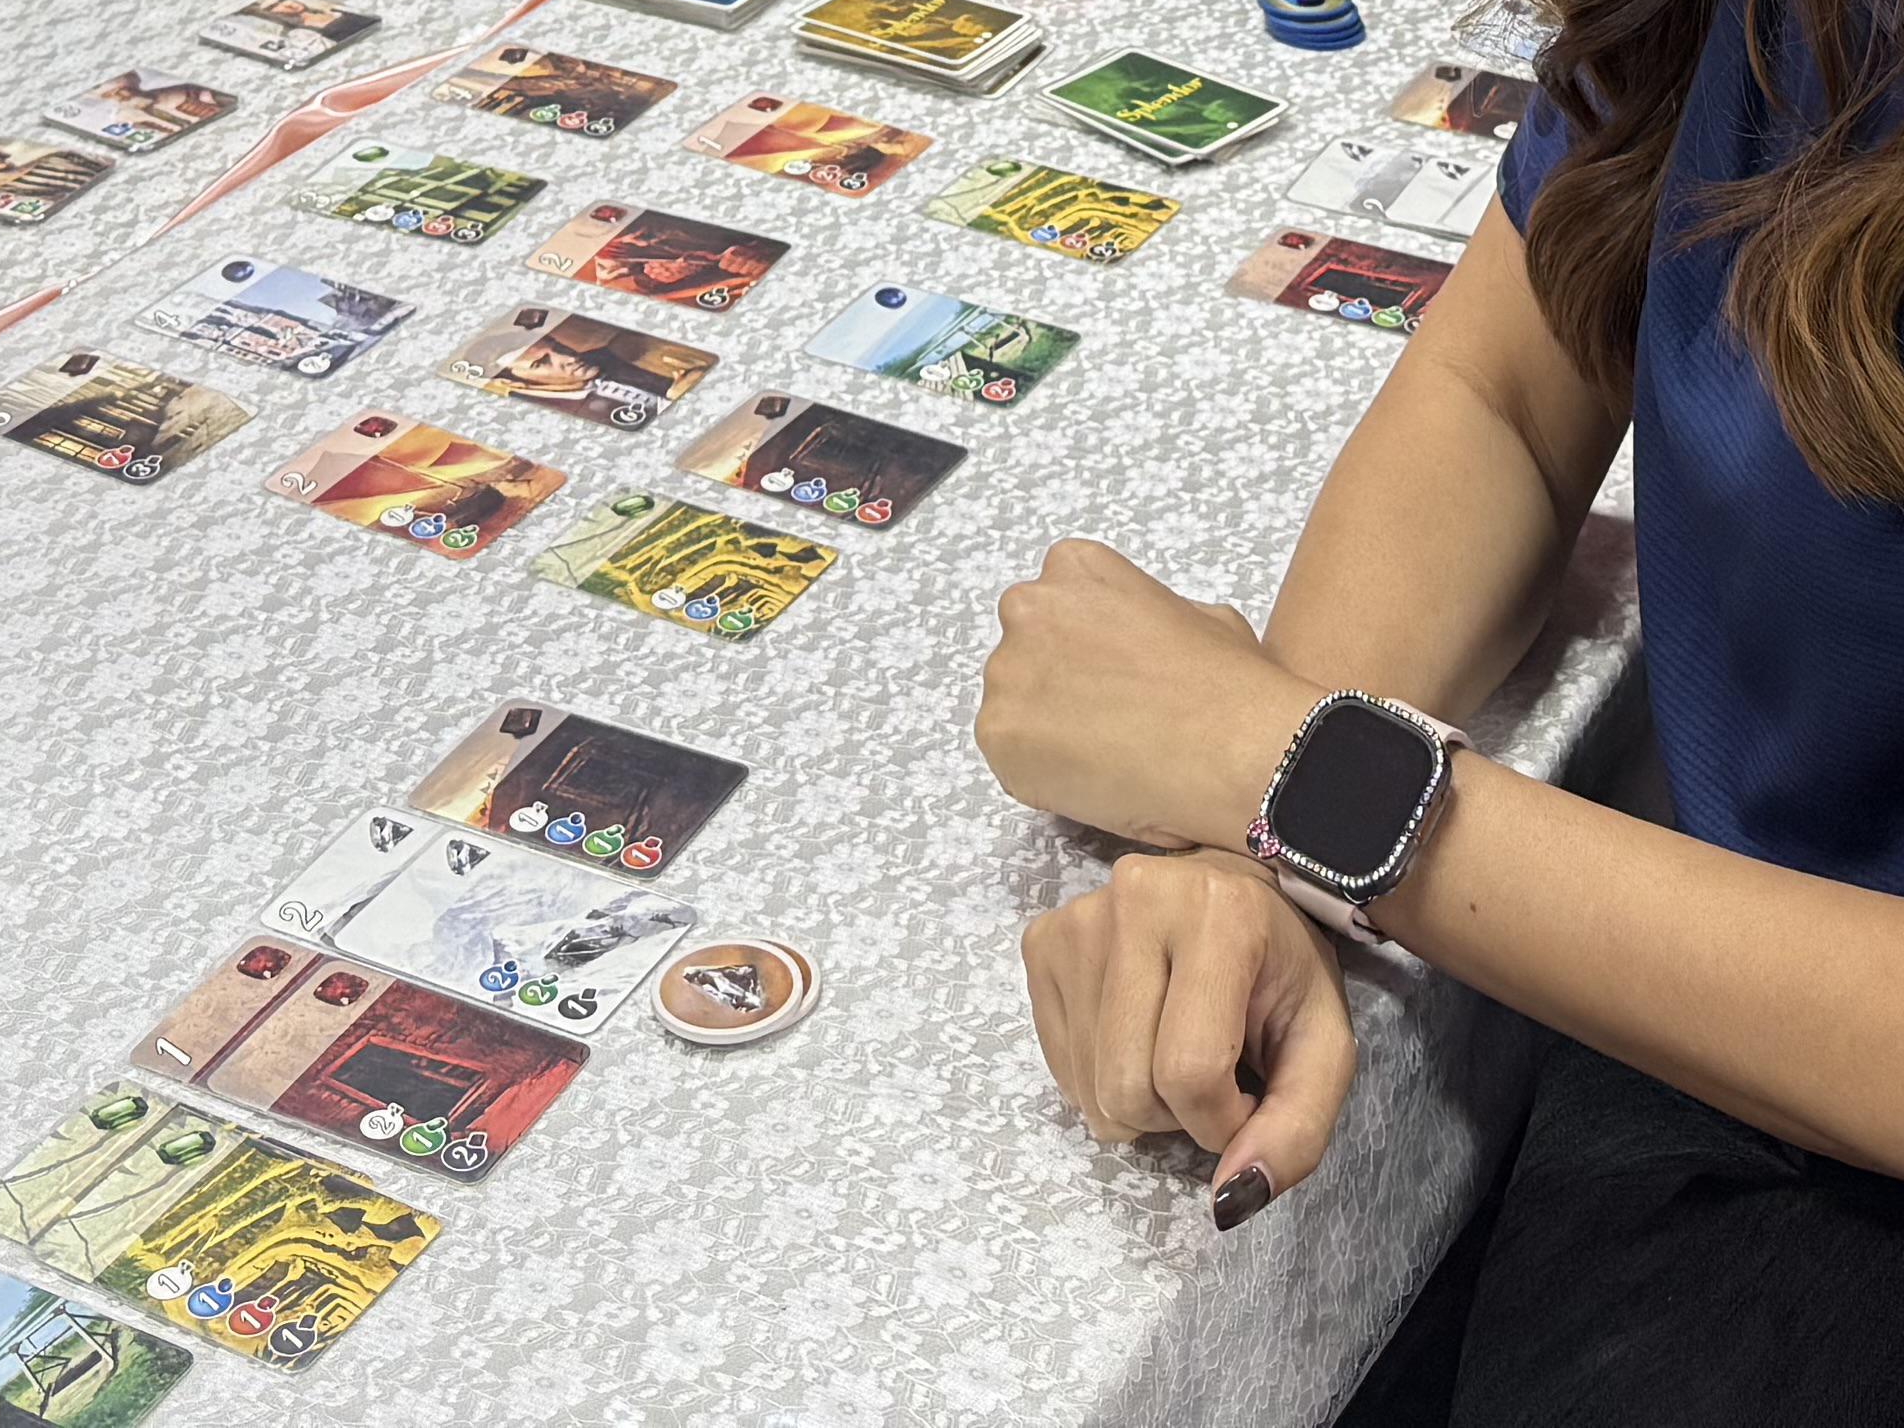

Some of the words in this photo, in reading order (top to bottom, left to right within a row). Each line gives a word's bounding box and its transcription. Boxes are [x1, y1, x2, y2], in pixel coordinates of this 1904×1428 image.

[1116, 77, 1203, 122] Splendor
[697, 134, 723, 151] 1
[538, 252, 574, 273] 2
[153, 309, 183, 329] 4
[450, 360, 485, 380] 3
[618, 408, 638, 422] 6
[101, 453, 120, 465] 7
[131, 462, 152, 477] 3
[280, 471, 318, 496] 2
[832, 496, 850, 509] 1
[864, 506, 883, 520] 1
[448, 532, 470, 547] 2
[657, 593, 678, 606] 1
[692, 603, 712, 617] 3
[726, 614, 745, 629] 1
[518, 812, 539, 828] 1
[555, 824, 576, 840] 1
[593, 835, 613, 852] 1
[631, 848, 651, 864] 1
[278, 899, 325, 933] 2
[487, 970, 512, 988] 2
[526, 984, 551, 1003] 2
[566, 999, 589, 1017] 1
[155, 1036, 193, 1067] 1
[368, 1115, 397, 1137] 2
[410, 1130, 434, 1150] 1
[451, 1145, 479, 1167] 2
[157, 1273, 181, 1294] 1
[197, 1291, 221, 1312] 1
[239, 1309, 262, 1330] 1
[280, 1327, 304, 1350] 1
